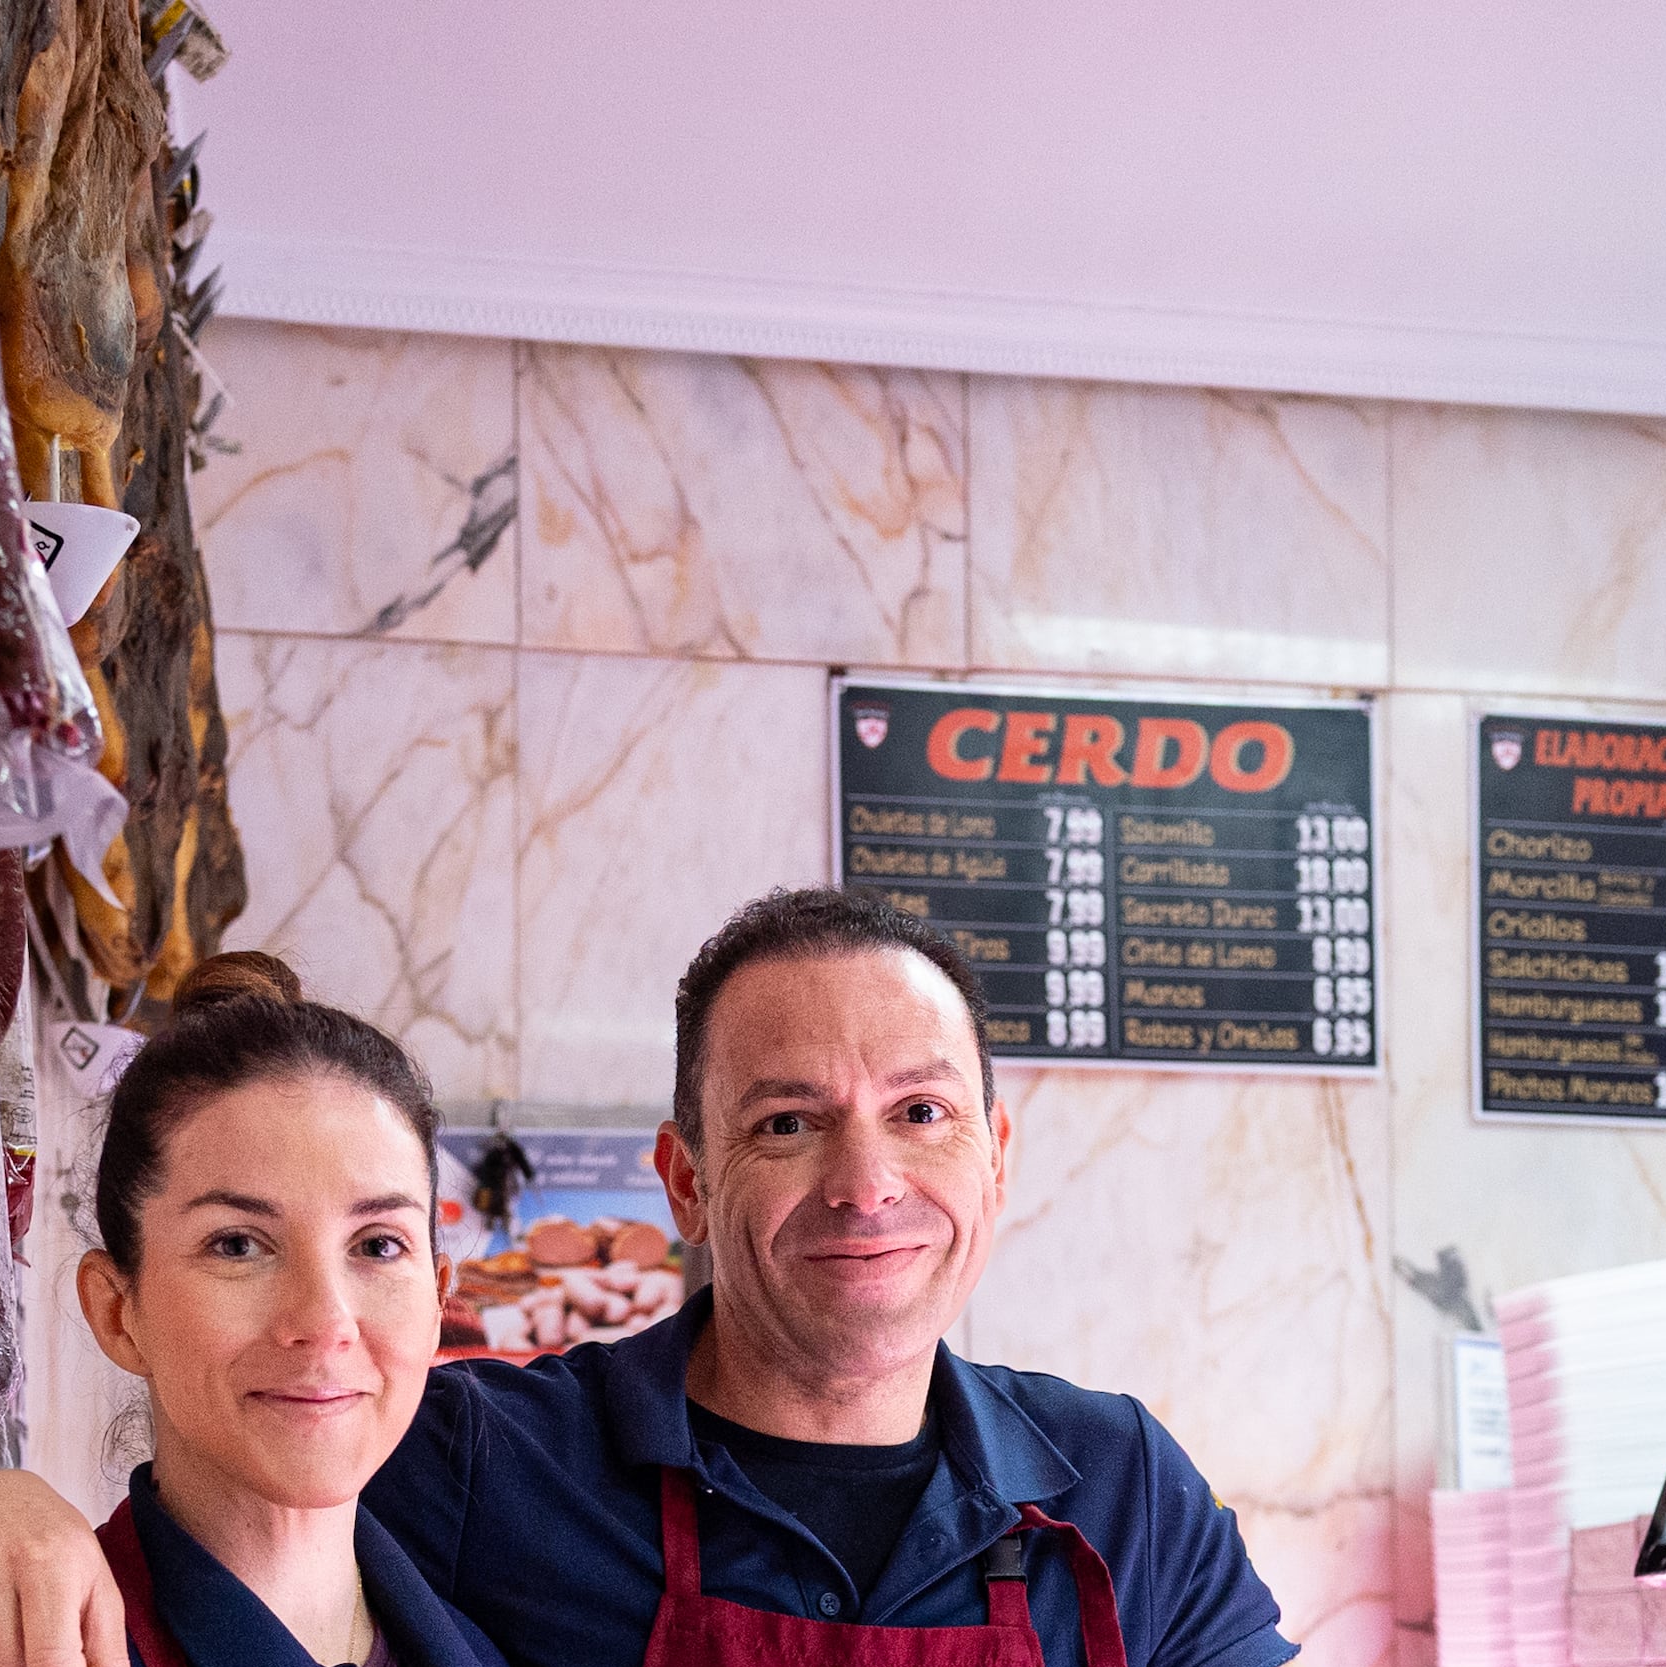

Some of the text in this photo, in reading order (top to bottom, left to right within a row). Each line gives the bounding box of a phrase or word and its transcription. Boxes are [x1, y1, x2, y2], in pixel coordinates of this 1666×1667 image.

[926, 706, 1295, 793] CERDO
[1119, 816, 1216, 847] Solomillo
[1486, 828, 1594, 862] Chorizo
[1486, 869, 1597, 901] Morcilla
[1121, 896, 1210, 927] Secreto
[1212, 898, 1279, 928] Duroc
[1487, 909, 1589, 942] Criollos
[1121, 937, 1181, 967] Cinta
[1186, 941, 1213, 968] de
[1216, 941, 1277, 969] Lomo
[1486, 948, 1630, 983] Salchichas
[1123, 979, 1206, 1008] Manos
[1488, 989, 1644, 1026] Hamburguesas
[1198, 1026, 1213, 1054] y
[1217, 1020, 1299, 1050] Orejas
[1488, 1030, 1621, 1066] Hamburguesas
